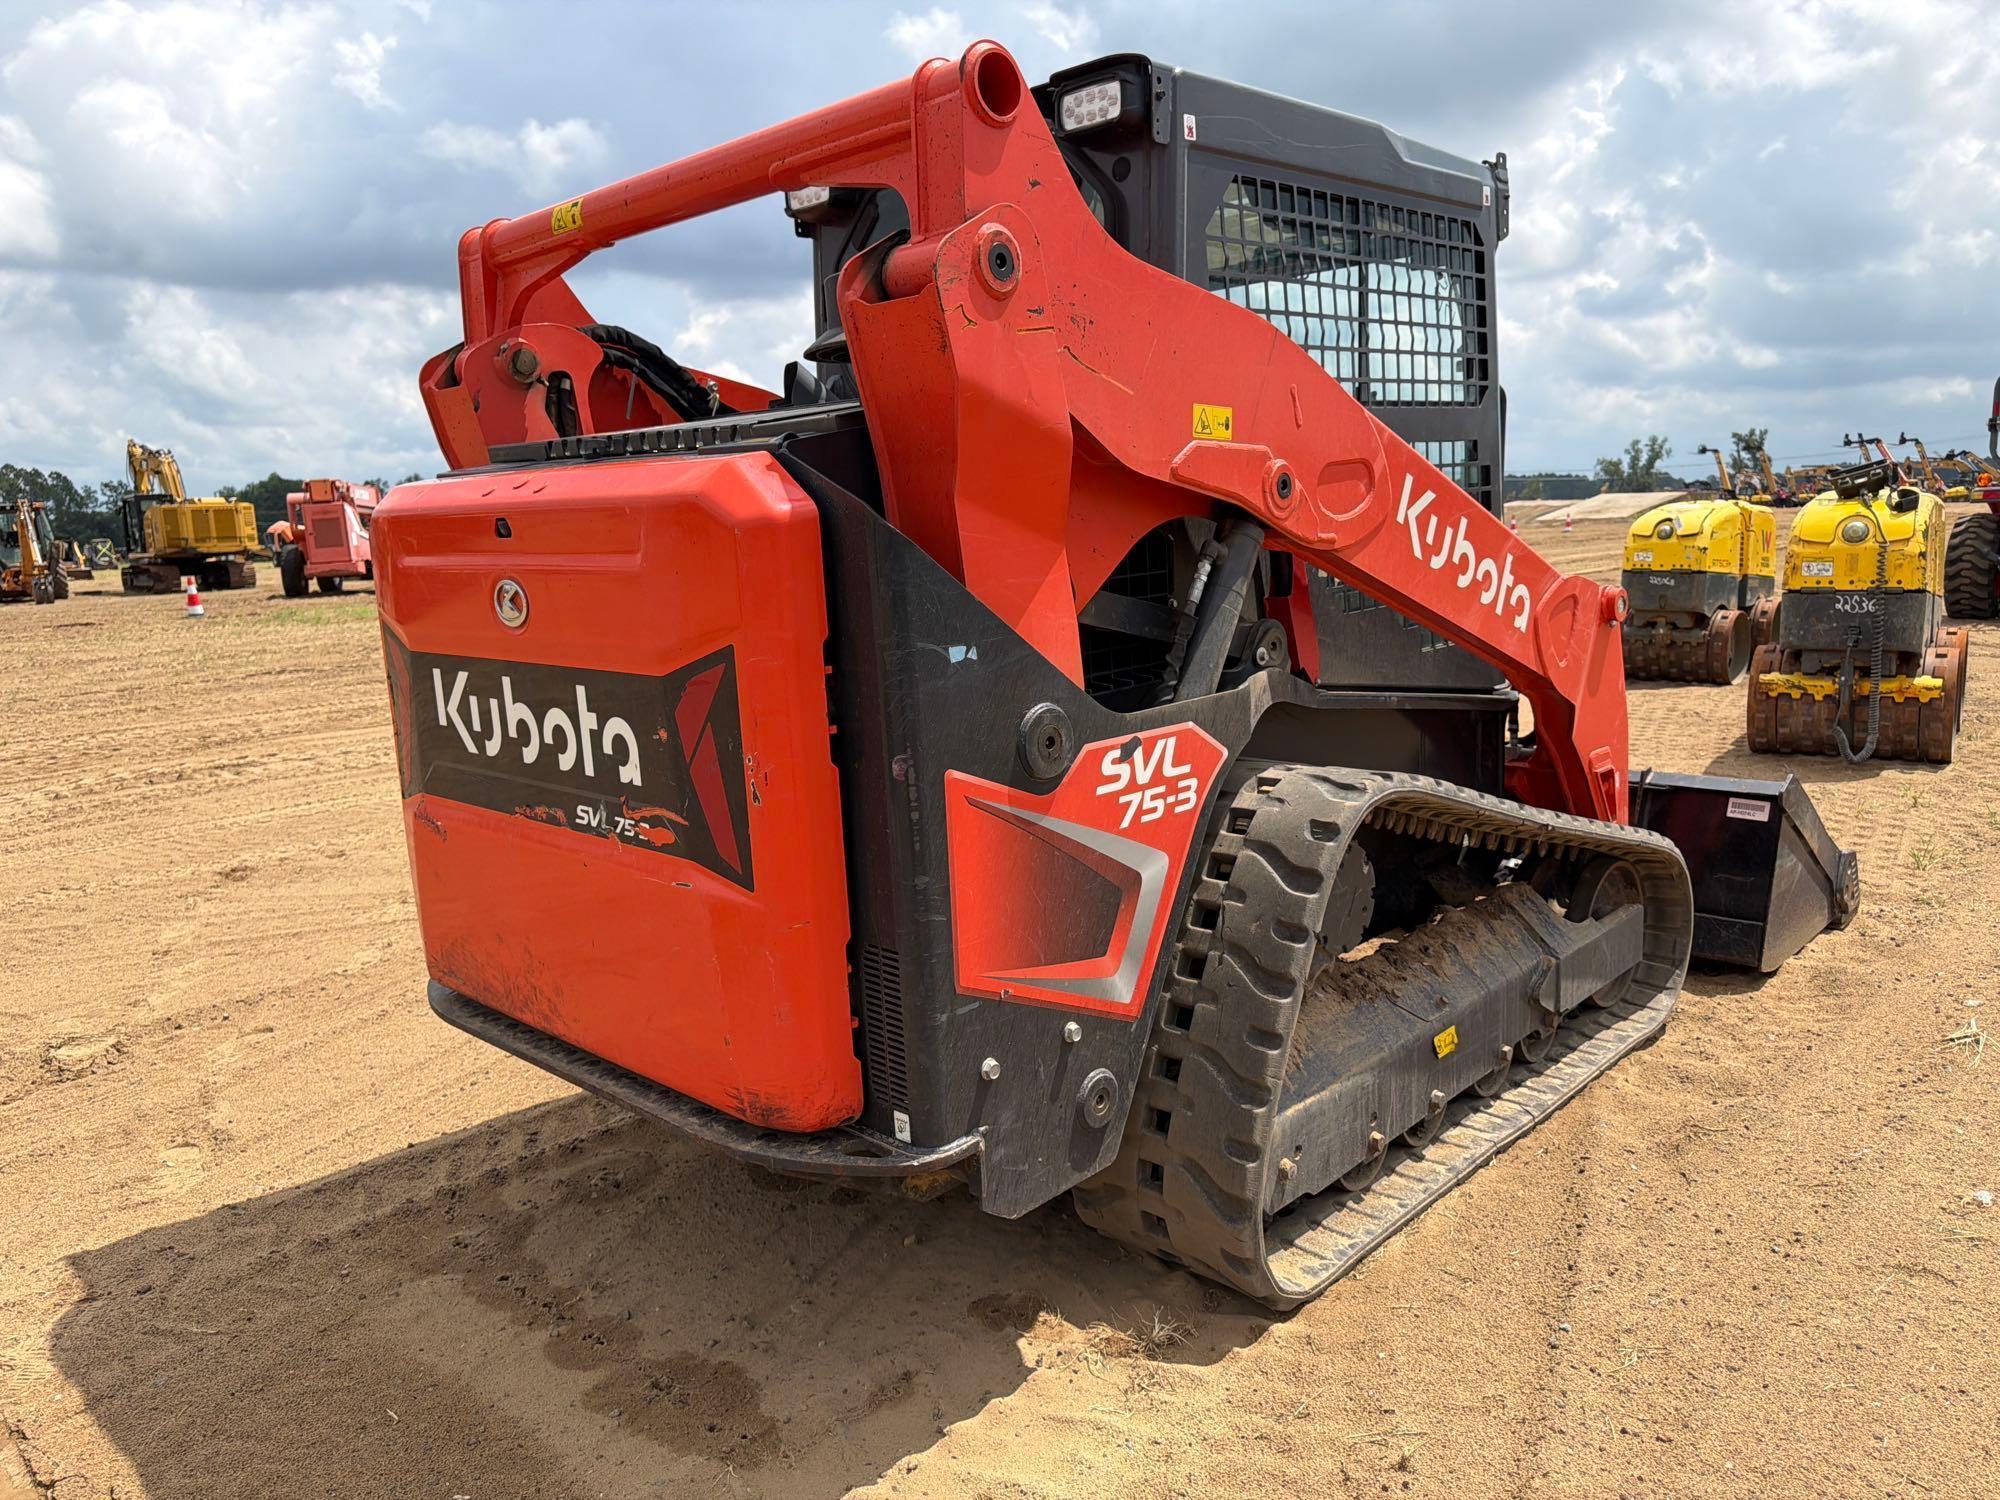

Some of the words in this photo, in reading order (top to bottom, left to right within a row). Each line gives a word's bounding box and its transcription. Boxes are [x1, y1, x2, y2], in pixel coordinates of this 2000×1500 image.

[1396, 472, 1531, 633] Kubota
[1835, 595, 1877, 614] 22536
[432, 668, 642, 786] Kubota
[1096, 736, 1192, 797] SVL
[575, 804, 614, 830] SVL
[1118, 777, 1199, 829] 75-3
